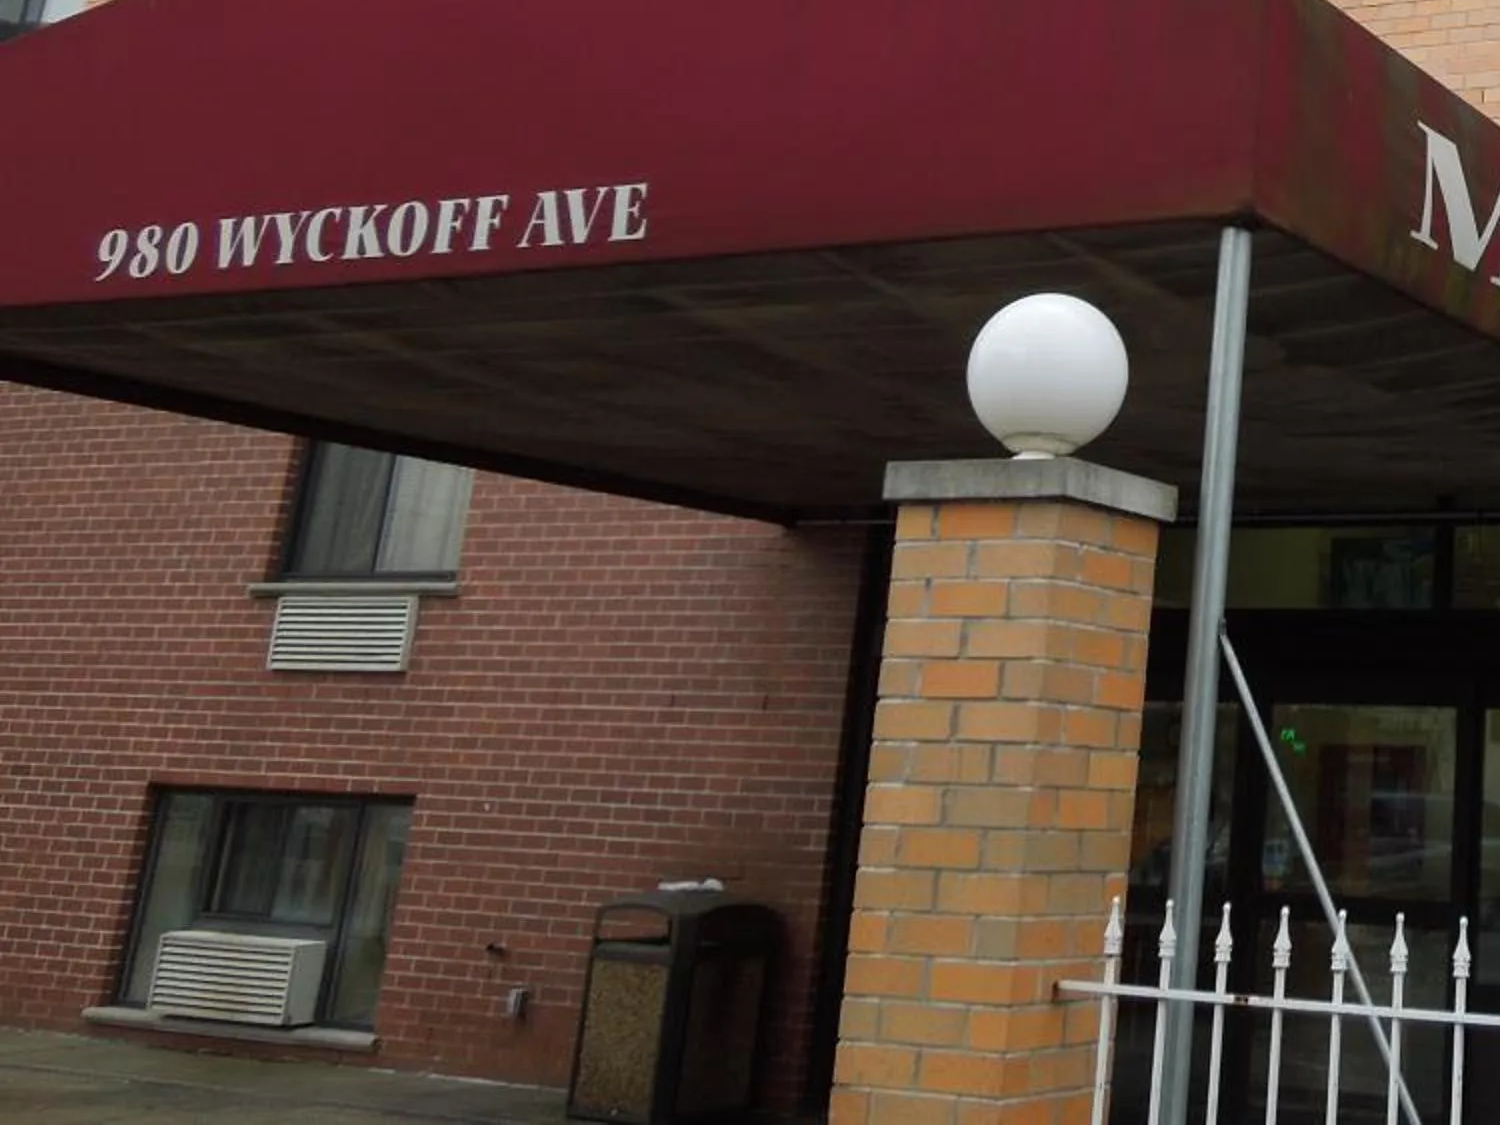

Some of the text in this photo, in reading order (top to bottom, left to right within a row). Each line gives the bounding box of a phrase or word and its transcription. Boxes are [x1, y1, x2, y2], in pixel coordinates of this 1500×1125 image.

[95, 183, 648, 281] 980 WYCKOFF AVE
